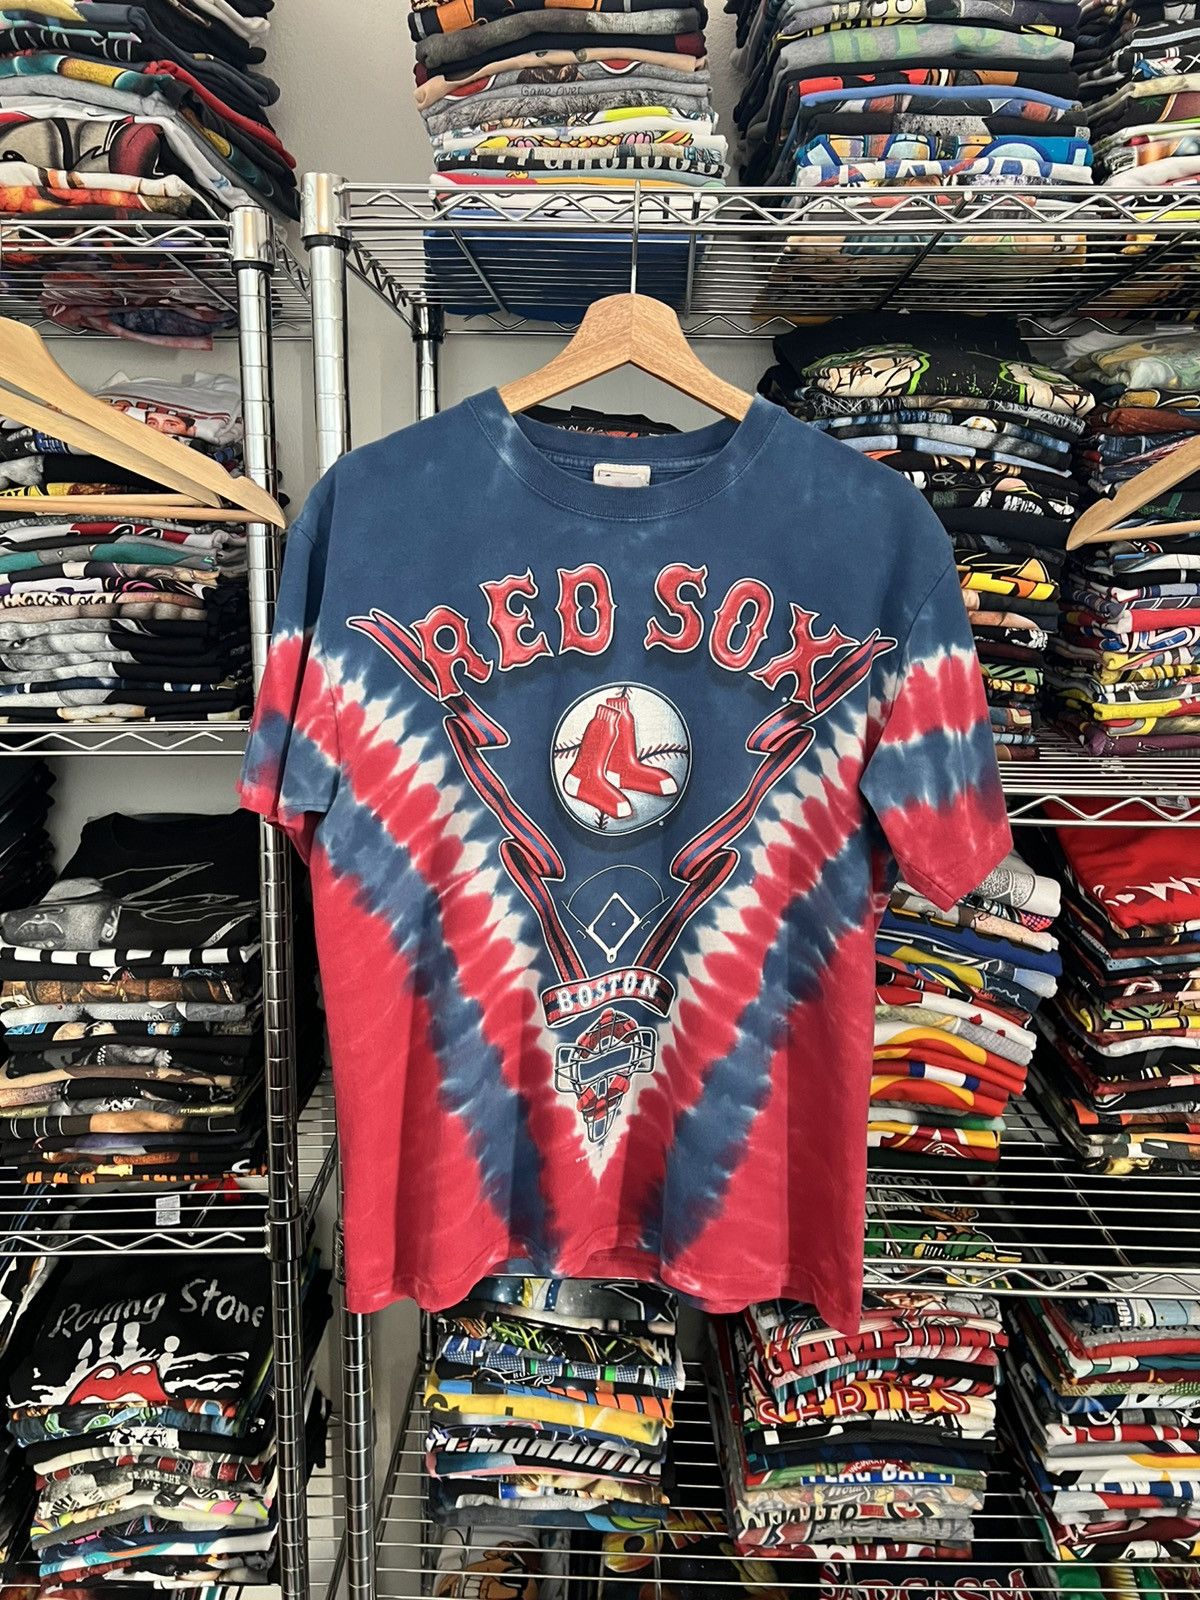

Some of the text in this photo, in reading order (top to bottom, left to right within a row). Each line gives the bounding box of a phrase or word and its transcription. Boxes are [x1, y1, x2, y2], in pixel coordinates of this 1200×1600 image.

[413, 562, 862, 712] RED SOX
[556, 971, 661, 1014] BOSTON
